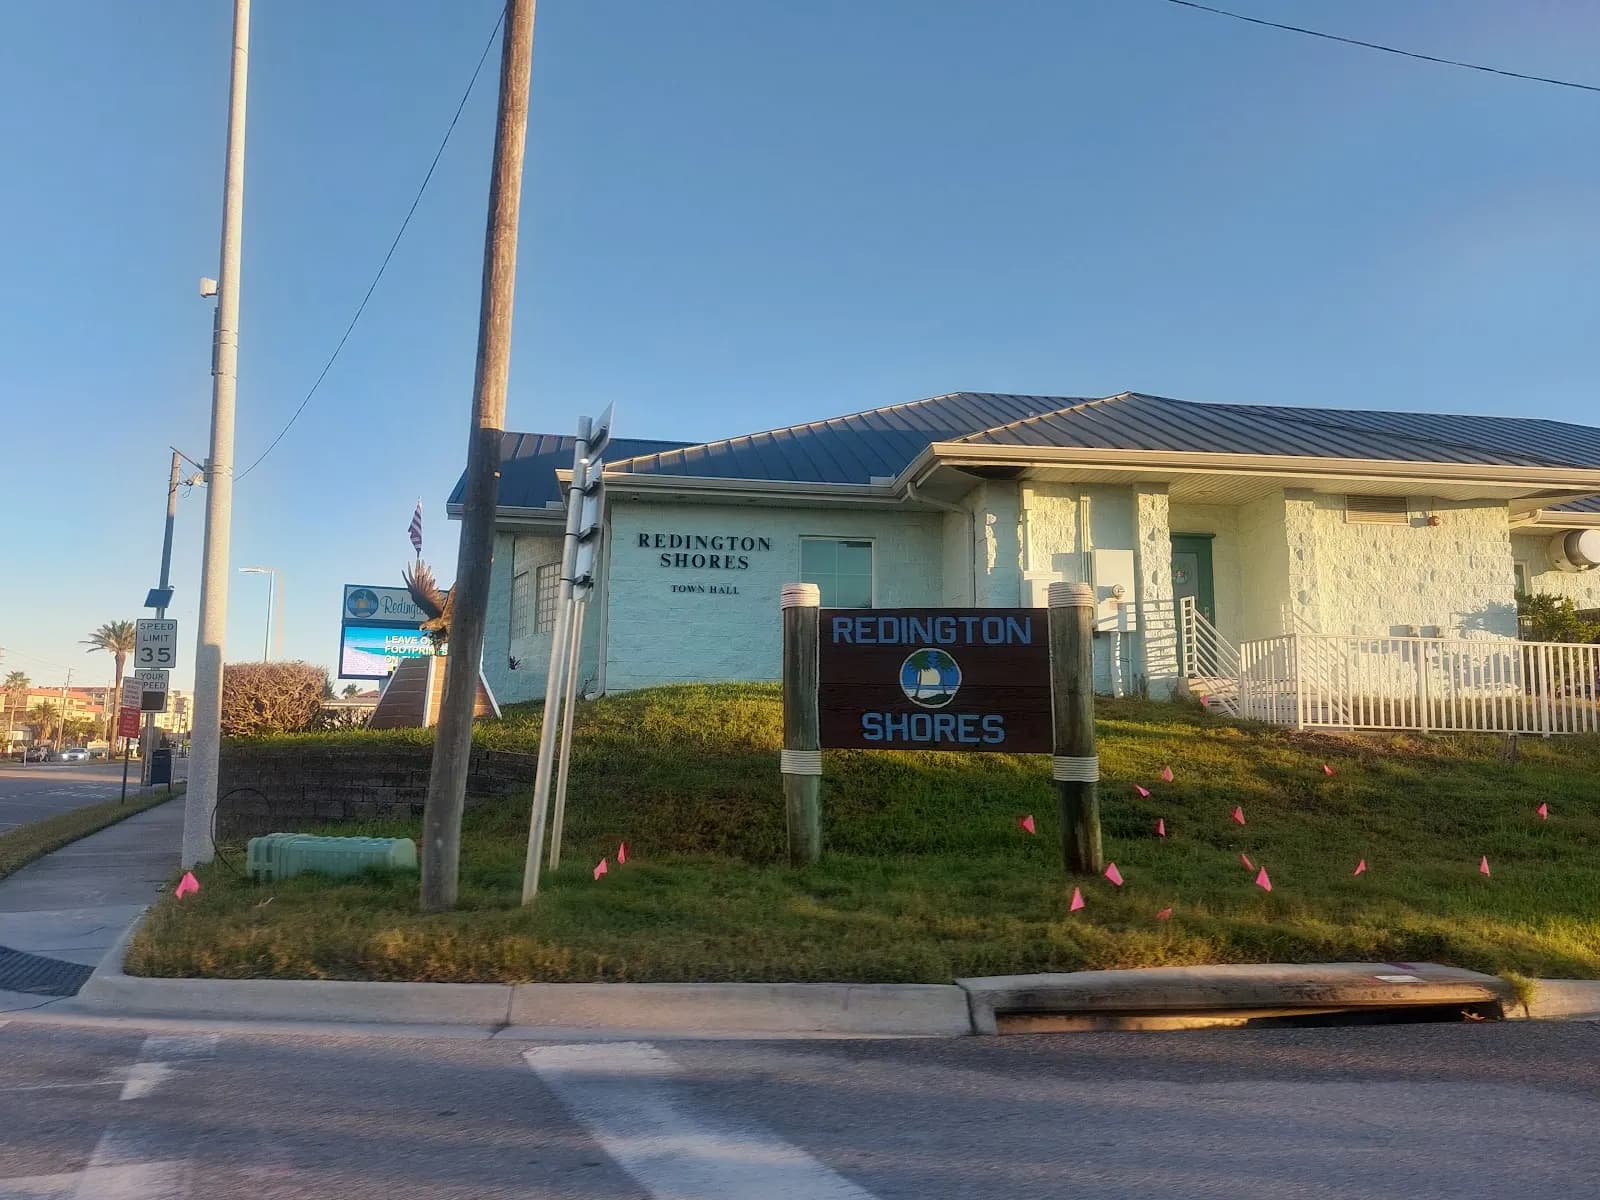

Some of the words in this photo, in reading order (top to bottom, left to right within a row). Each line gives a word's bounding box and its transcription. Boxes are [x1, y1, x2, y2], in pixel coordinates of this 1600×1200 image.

[638, 532, 771, 551] REDINGTON
[660, 553, 749, 569] SHORES
[671, 584, 705, 593] TOWN
[709, 585, 740, 595] HALL
[140, 622, 174, 631] SPEED
[832, 616, 1032, 644] REDINGTON
[143, 634, 169, 642] LIMIT
[385, 635, 417, 644] LEAVE
[140, 647, 171, 662] 35
[140, 672, 164, 681] YOUR
[143, 681, 166, 689] PEED
[861, 712, 1006, 743] SHORES
